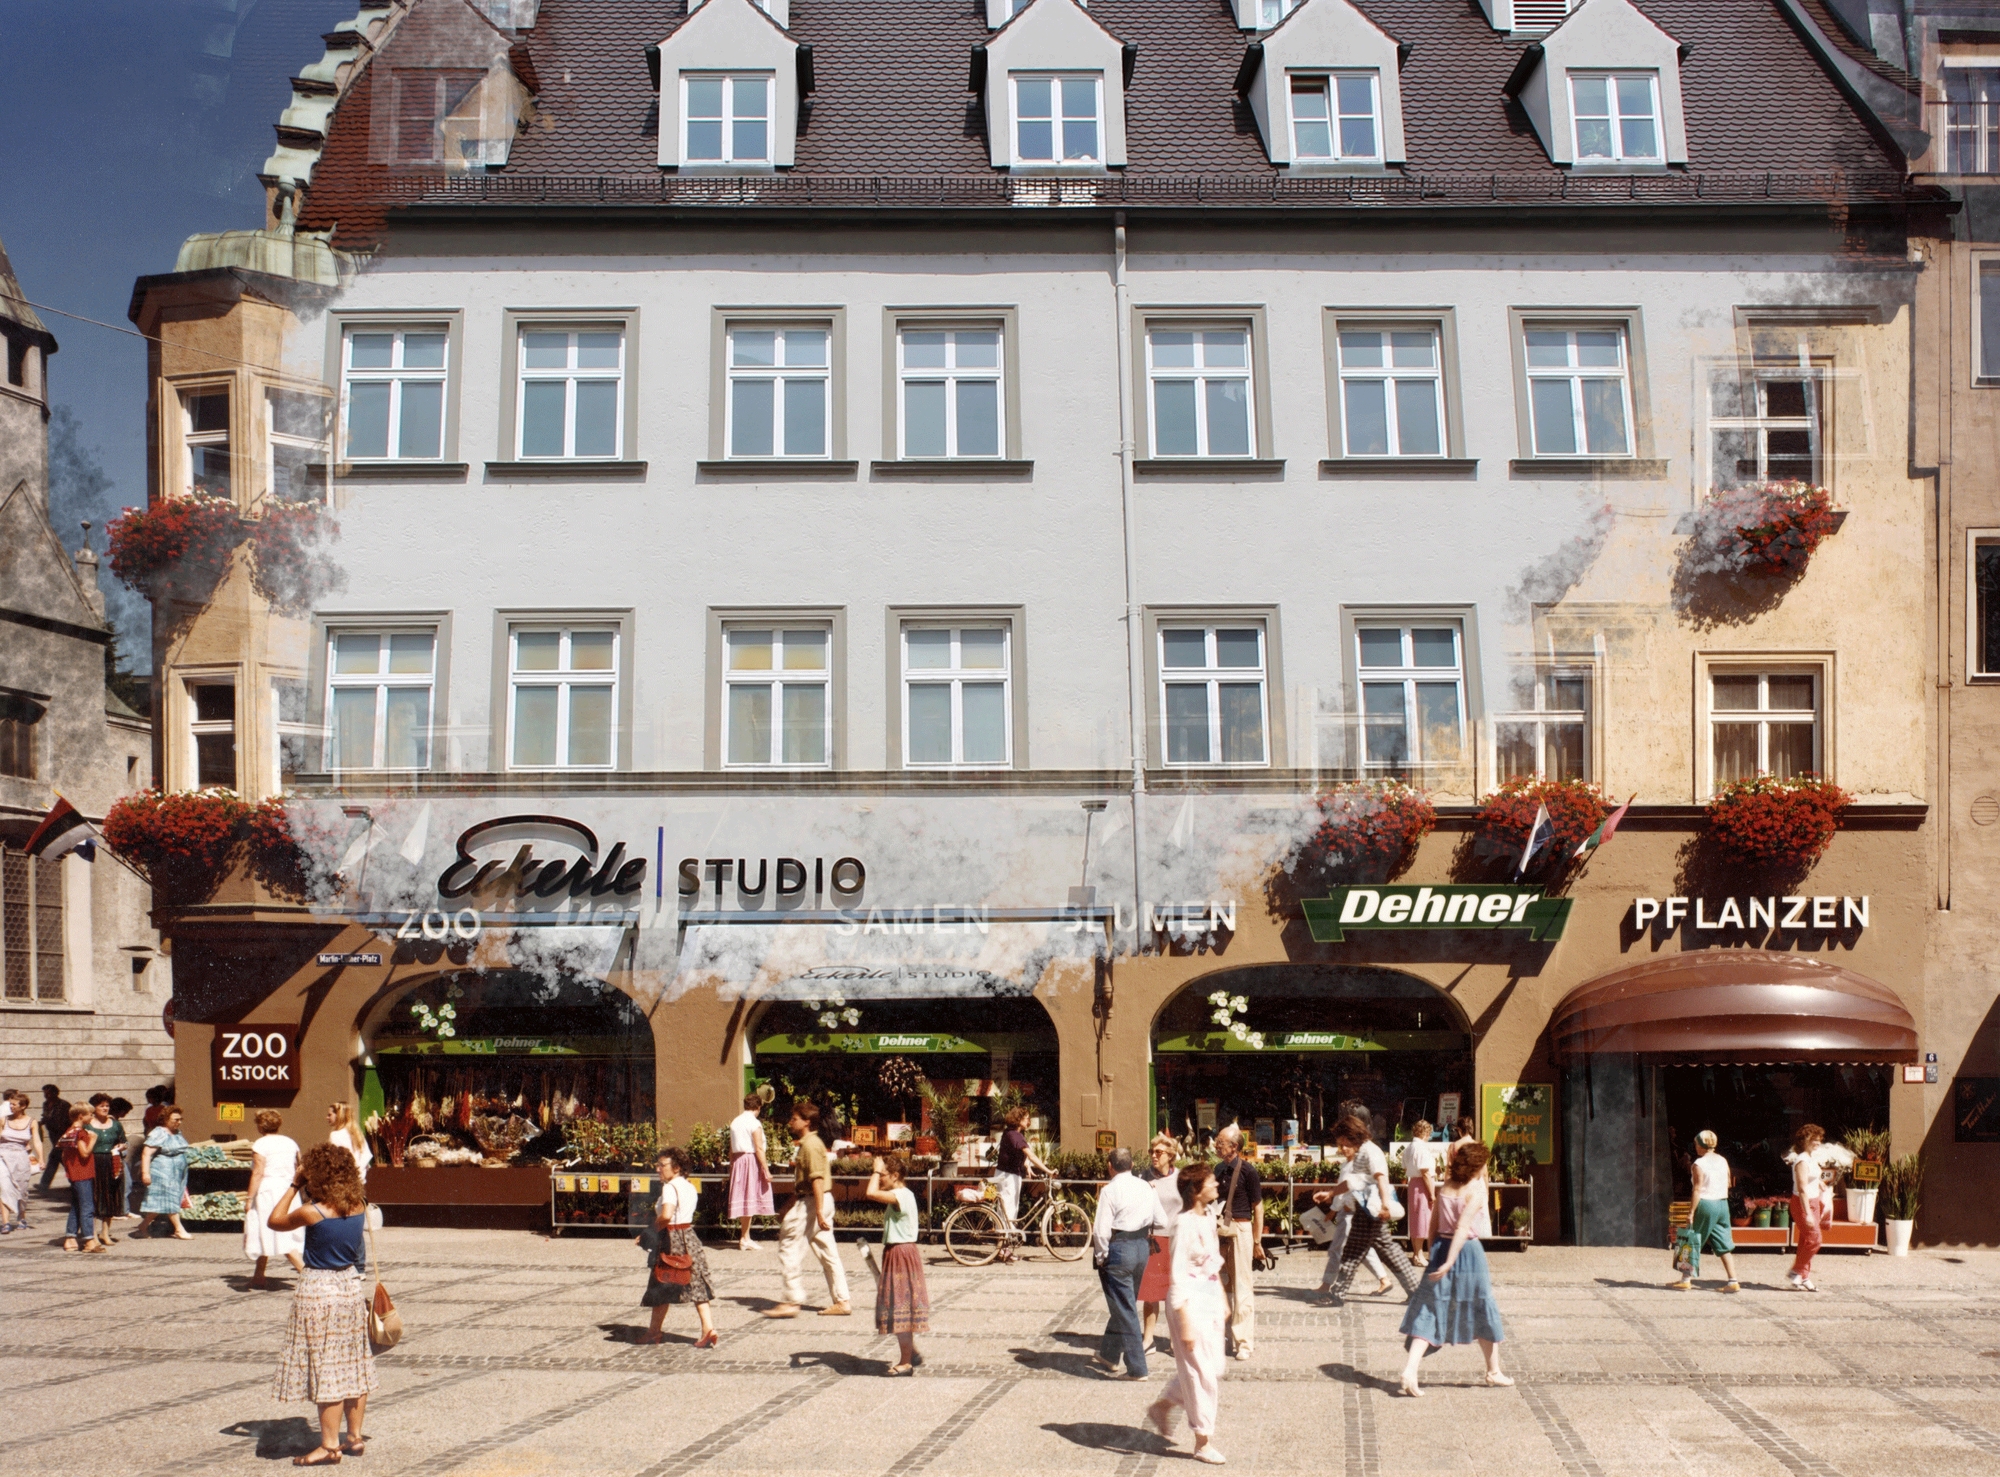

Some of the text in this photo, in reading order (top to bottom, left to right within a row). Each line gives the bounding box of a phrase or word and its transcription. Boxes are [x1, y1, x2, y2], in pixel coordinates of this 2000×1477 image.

[437, 815, 866, 898] Eckerle STUDIO
[1339, 888, 1539, 923] Dehner
[1635, 896, 1869, 930] PFLANZEN
[397, 907, 482, 939] ZOO
[833, 903, 989, 937] SAMEN
[1058, 899, 1237, 933] BLUMEN
[908, 970, 992, 979] STUDIO
[222, 1032, 287, 1058] ZOO
[493, 1037, 543, 1048] Dehner
[878, 1034, 930, 1046] Dehner
[1283, 1033, 1337, 1045] Dehner
[1928, 1053, 1934, 1062] 6
[219, 1065, 290, 1080] 1.STOCK
[1491, 1111, 1542, 1126] Grüner
[1493, 1130, 1537, 1144] Markt
